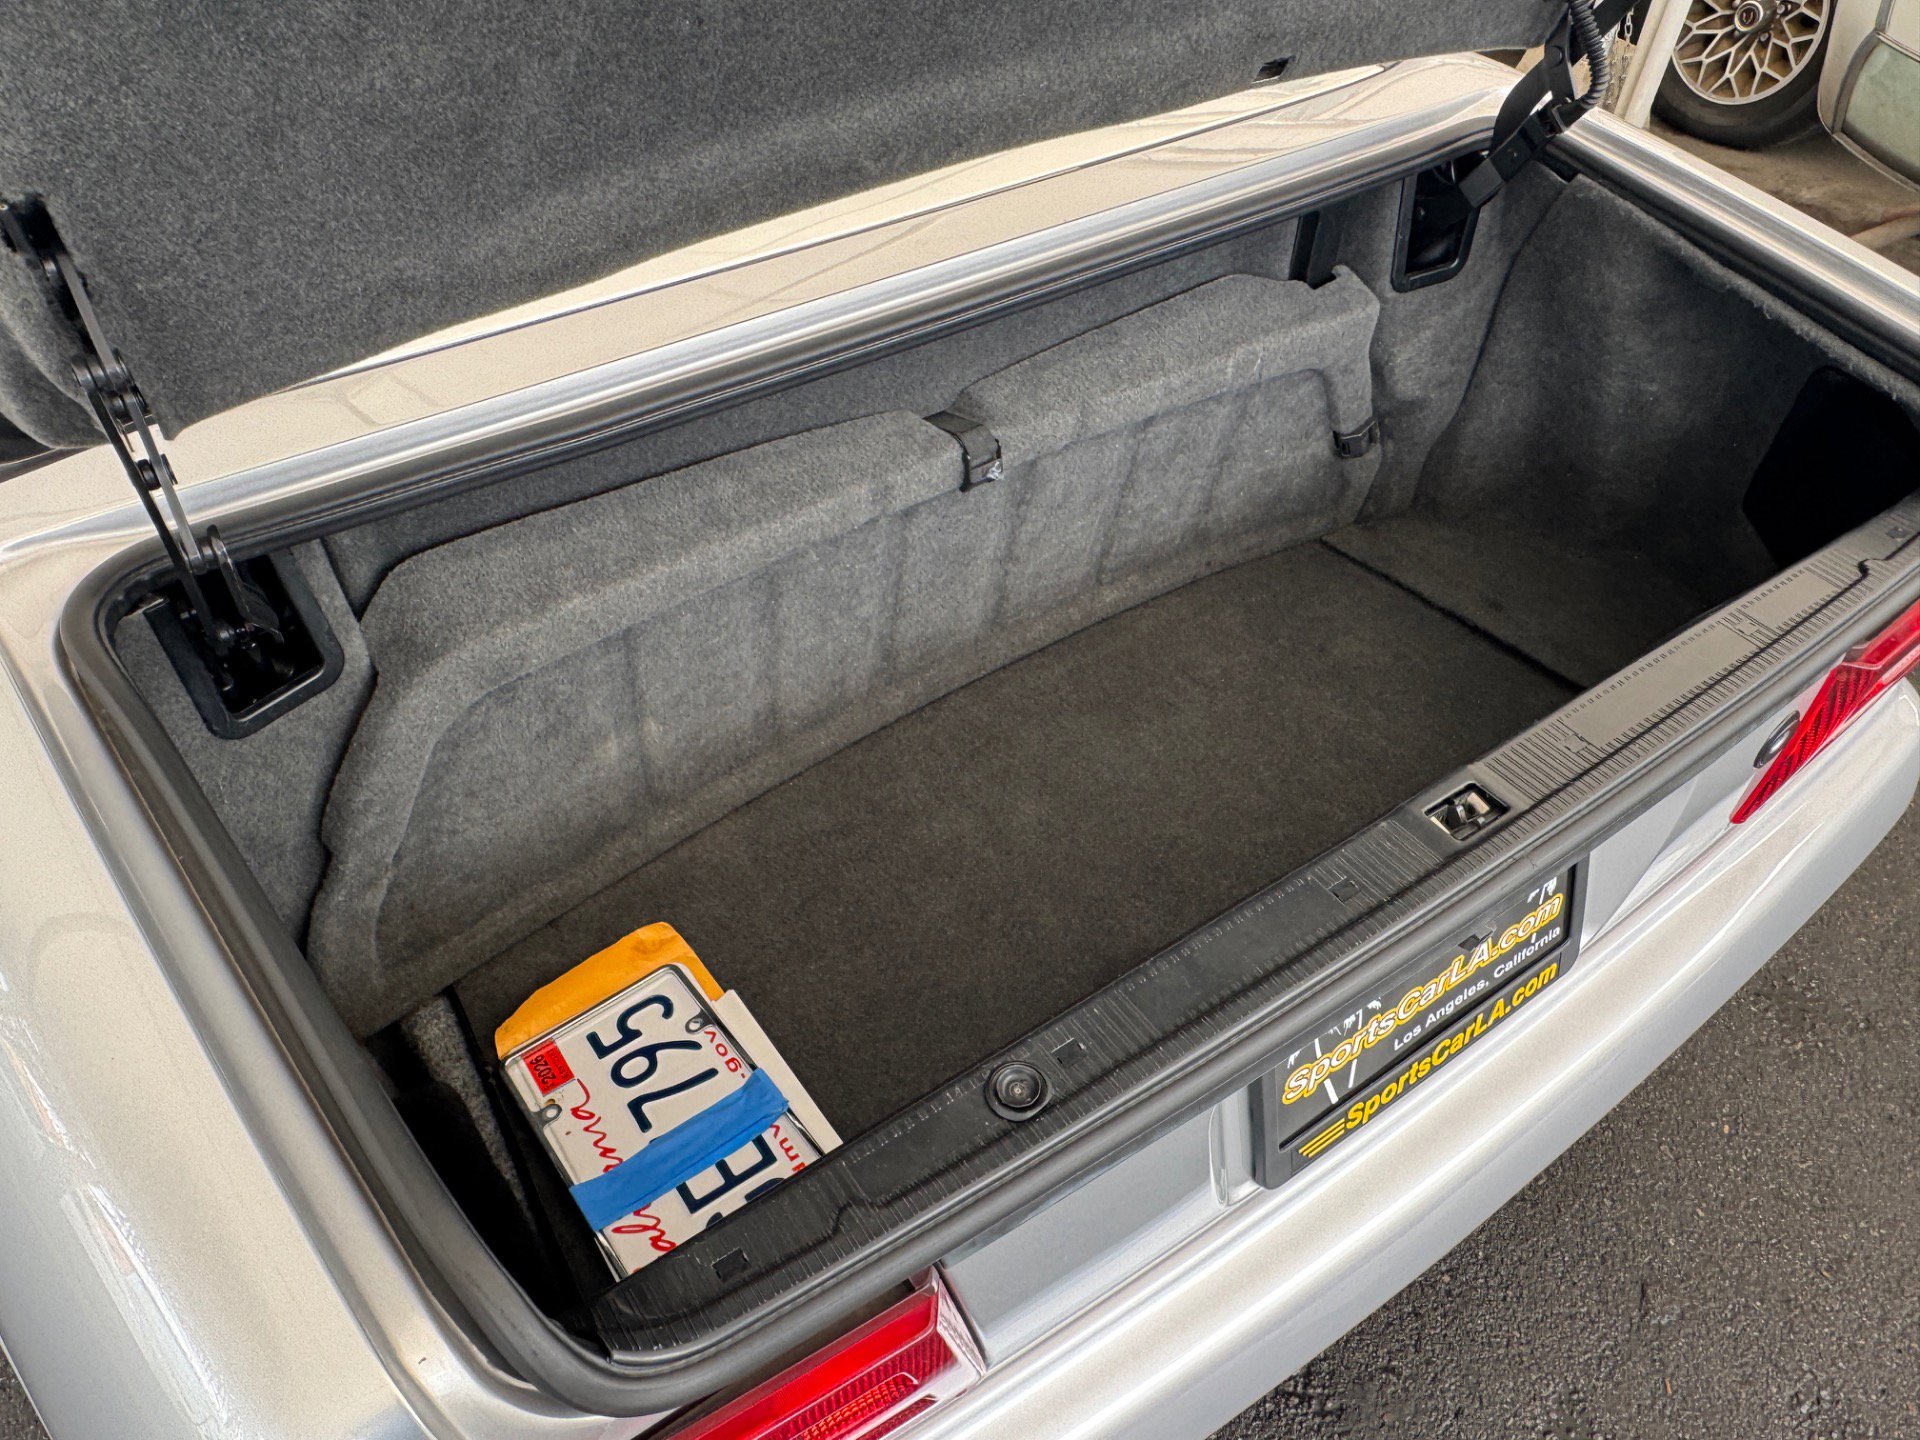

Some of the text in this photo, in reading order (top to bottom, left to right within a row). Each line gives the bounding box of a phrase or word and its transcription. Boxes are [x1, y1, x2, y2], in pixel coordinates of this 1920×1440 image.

[1282, 893, 1563, 1104] SportsCarLA.com
[1346, 962, 1558, 1128] SportsCarLA.com
[1394, 926, 1561, 1051] Los Angeles, California
[530, 1054, 557, 1085] 2026
